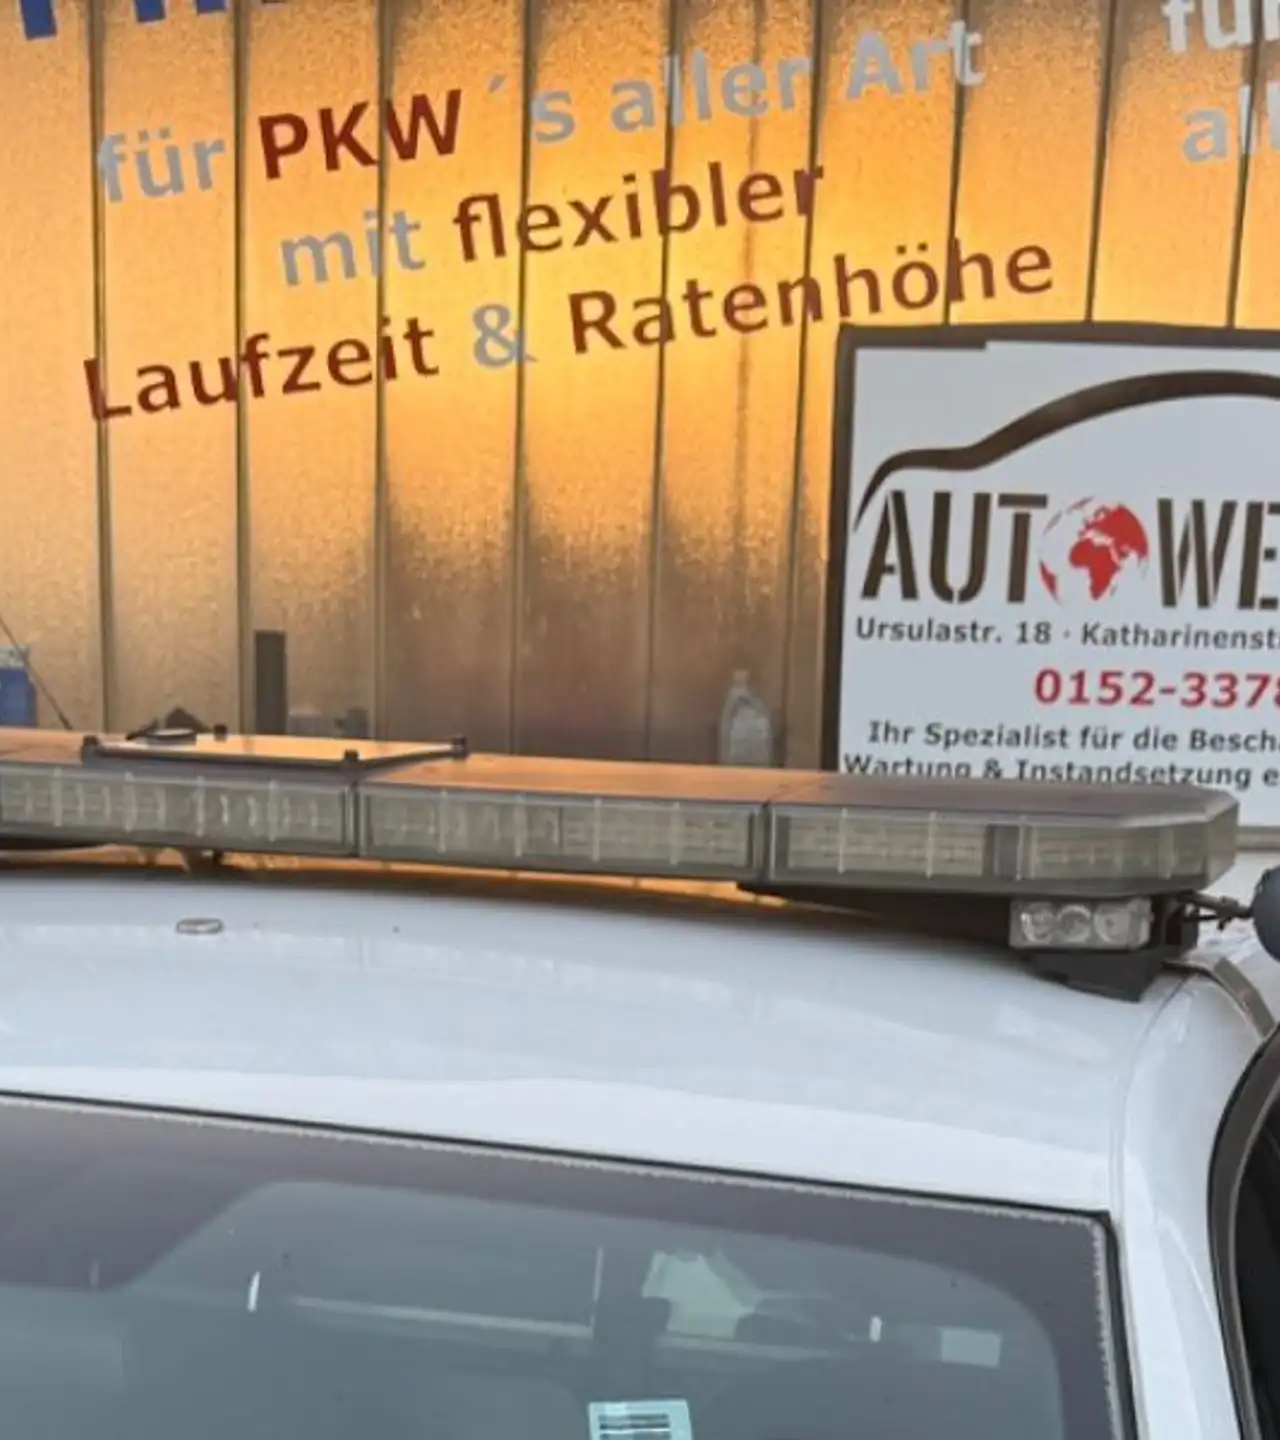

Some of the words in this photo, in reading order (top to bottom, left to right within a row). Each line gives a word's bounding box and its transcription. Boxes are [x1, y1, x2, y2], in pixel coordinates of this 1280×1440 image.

[97, 128, 225, 203] für
[610, 47, 812, 133] aller
[844, 20, 985, 100] Art
[279, 208, 426, 286] mit
[454, 161, 825, 262] flexibler
[84, 316, 440, 422] Laufzeit
[471, 303, 536, 369] &
[568, 237, 1055, 355] Ratenhöhe
[855, 616, 1003, 645] Ursulastr.
[1016, 622, 1052, 645] 18
[867, 719, 915, 745] Ihr
[924, 721, 1070, 753] Spezialist
[1080, 724, 1124, 750] für
[1132, 724, 1179, 750] die
[983, 759, 1005, 779] &
[1017, 758, 1253, 788] Instandsetzung
